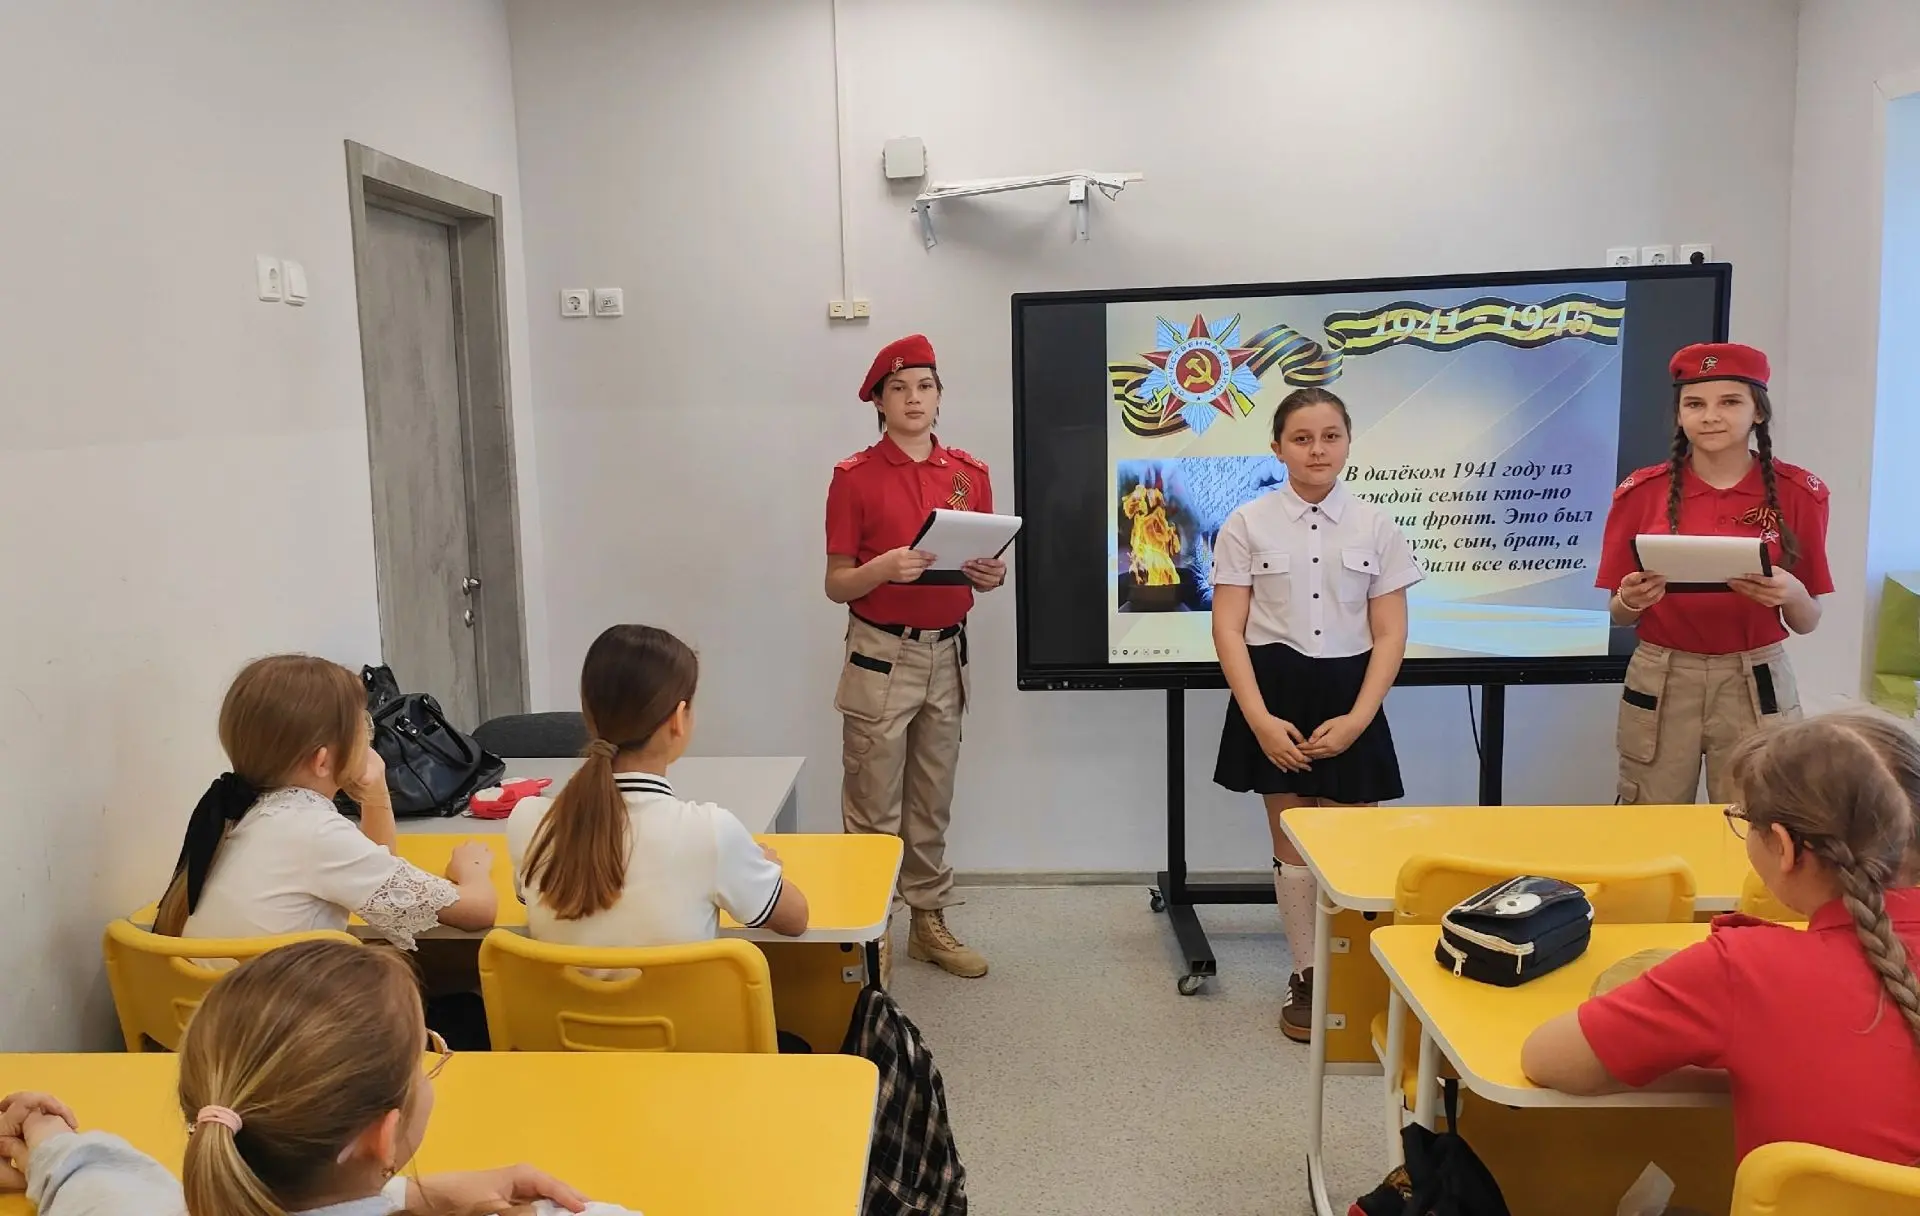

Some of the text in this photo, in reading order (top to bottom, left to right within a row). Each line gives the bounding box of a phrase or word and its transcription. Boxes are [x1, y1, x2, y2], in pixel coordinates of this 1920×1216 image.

[1371, 308, 1460, 343] 1941
[1500, 301, 1597, 339] 1945
[1344, 460, 1573, 482] В далёком 1941 году из
[1428, 486, 1488, 503] семьи
[1493, 485, 1572, 501] кто-то
[1422, 510, 1497, 531] фронт.
[1504, 508, 1548, 525] Это
[1553, 508, 1593, 524] был
[1406, 532, 1579, 552] уж, сын, брат, а
[1471, 558, 1503, 572] все
[1508, 556, 1588, 572] вместе.
